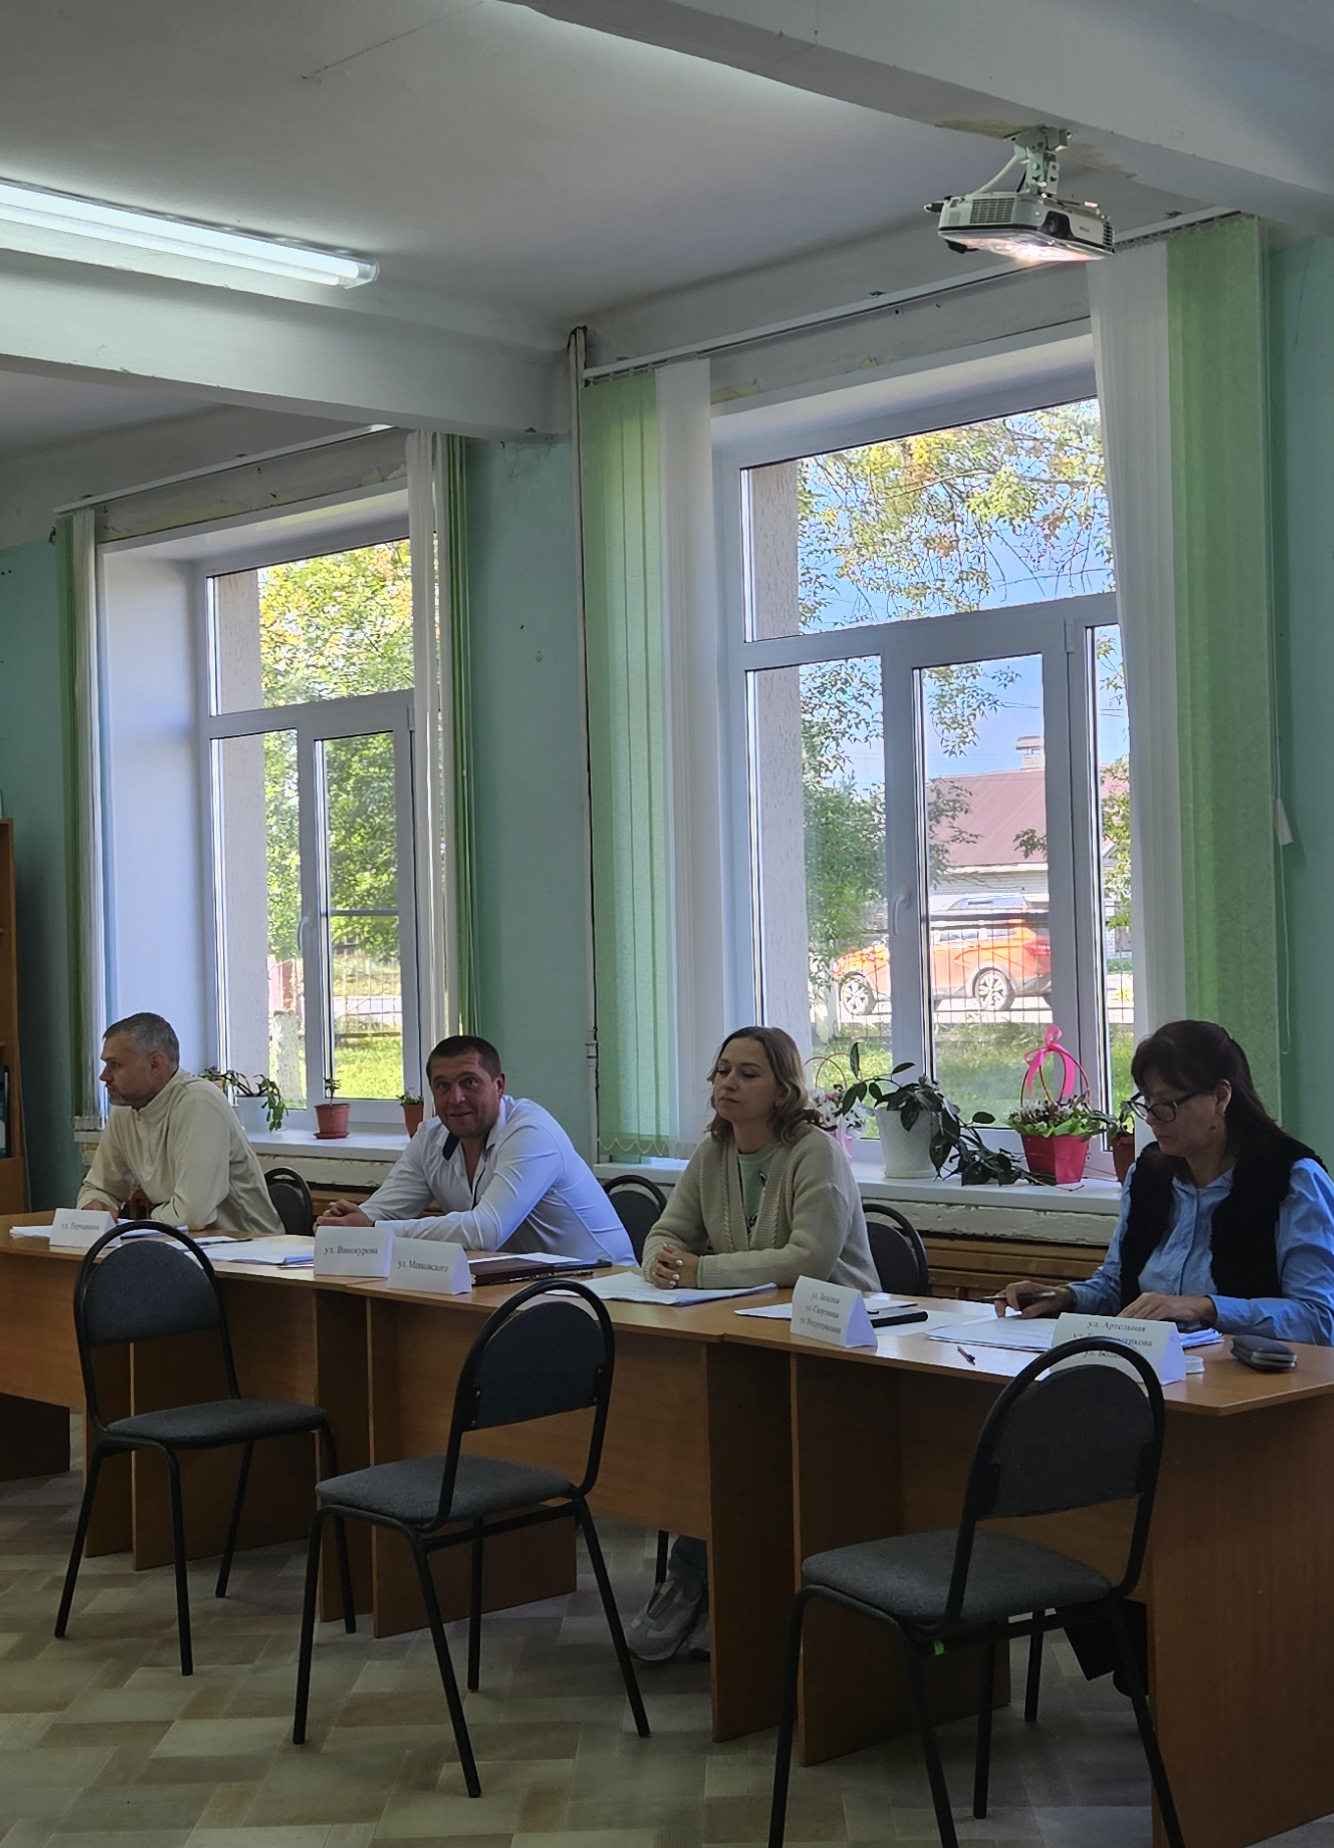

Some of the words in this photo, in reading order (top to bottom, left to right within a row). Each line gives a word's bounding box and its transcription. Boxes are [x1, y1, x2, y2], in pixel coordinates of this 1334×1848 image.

[323, 1247, 336, 1256] ул.
[337, 1245, 379, 1257] Винокурова
[397, 1260, 407, 1269] ул.
[1087, 1321, 1099, 1329] ул.
[1102, 1321, 1147, 1333] Артельная
